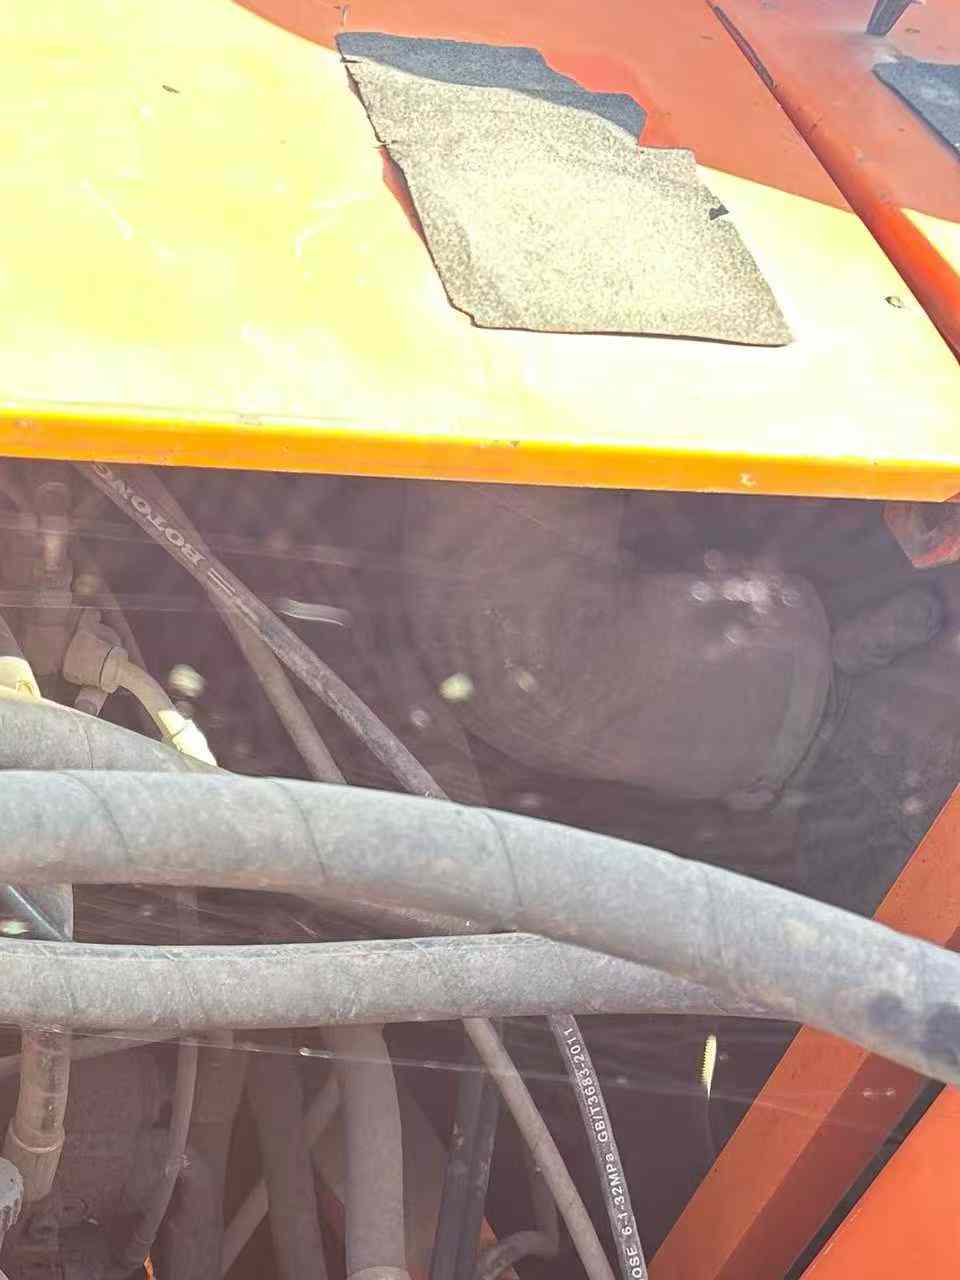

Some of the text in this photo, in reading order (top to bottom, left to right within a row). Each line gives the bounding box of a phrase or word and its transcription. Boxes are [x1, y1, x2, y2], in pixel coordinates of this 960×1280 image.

[95, 463, 207, 566] BOTONG
[563, 1027, 609, 1143] GB/T3683-2011
[605, 1152, 633, 1236] 6-1-32MPa
